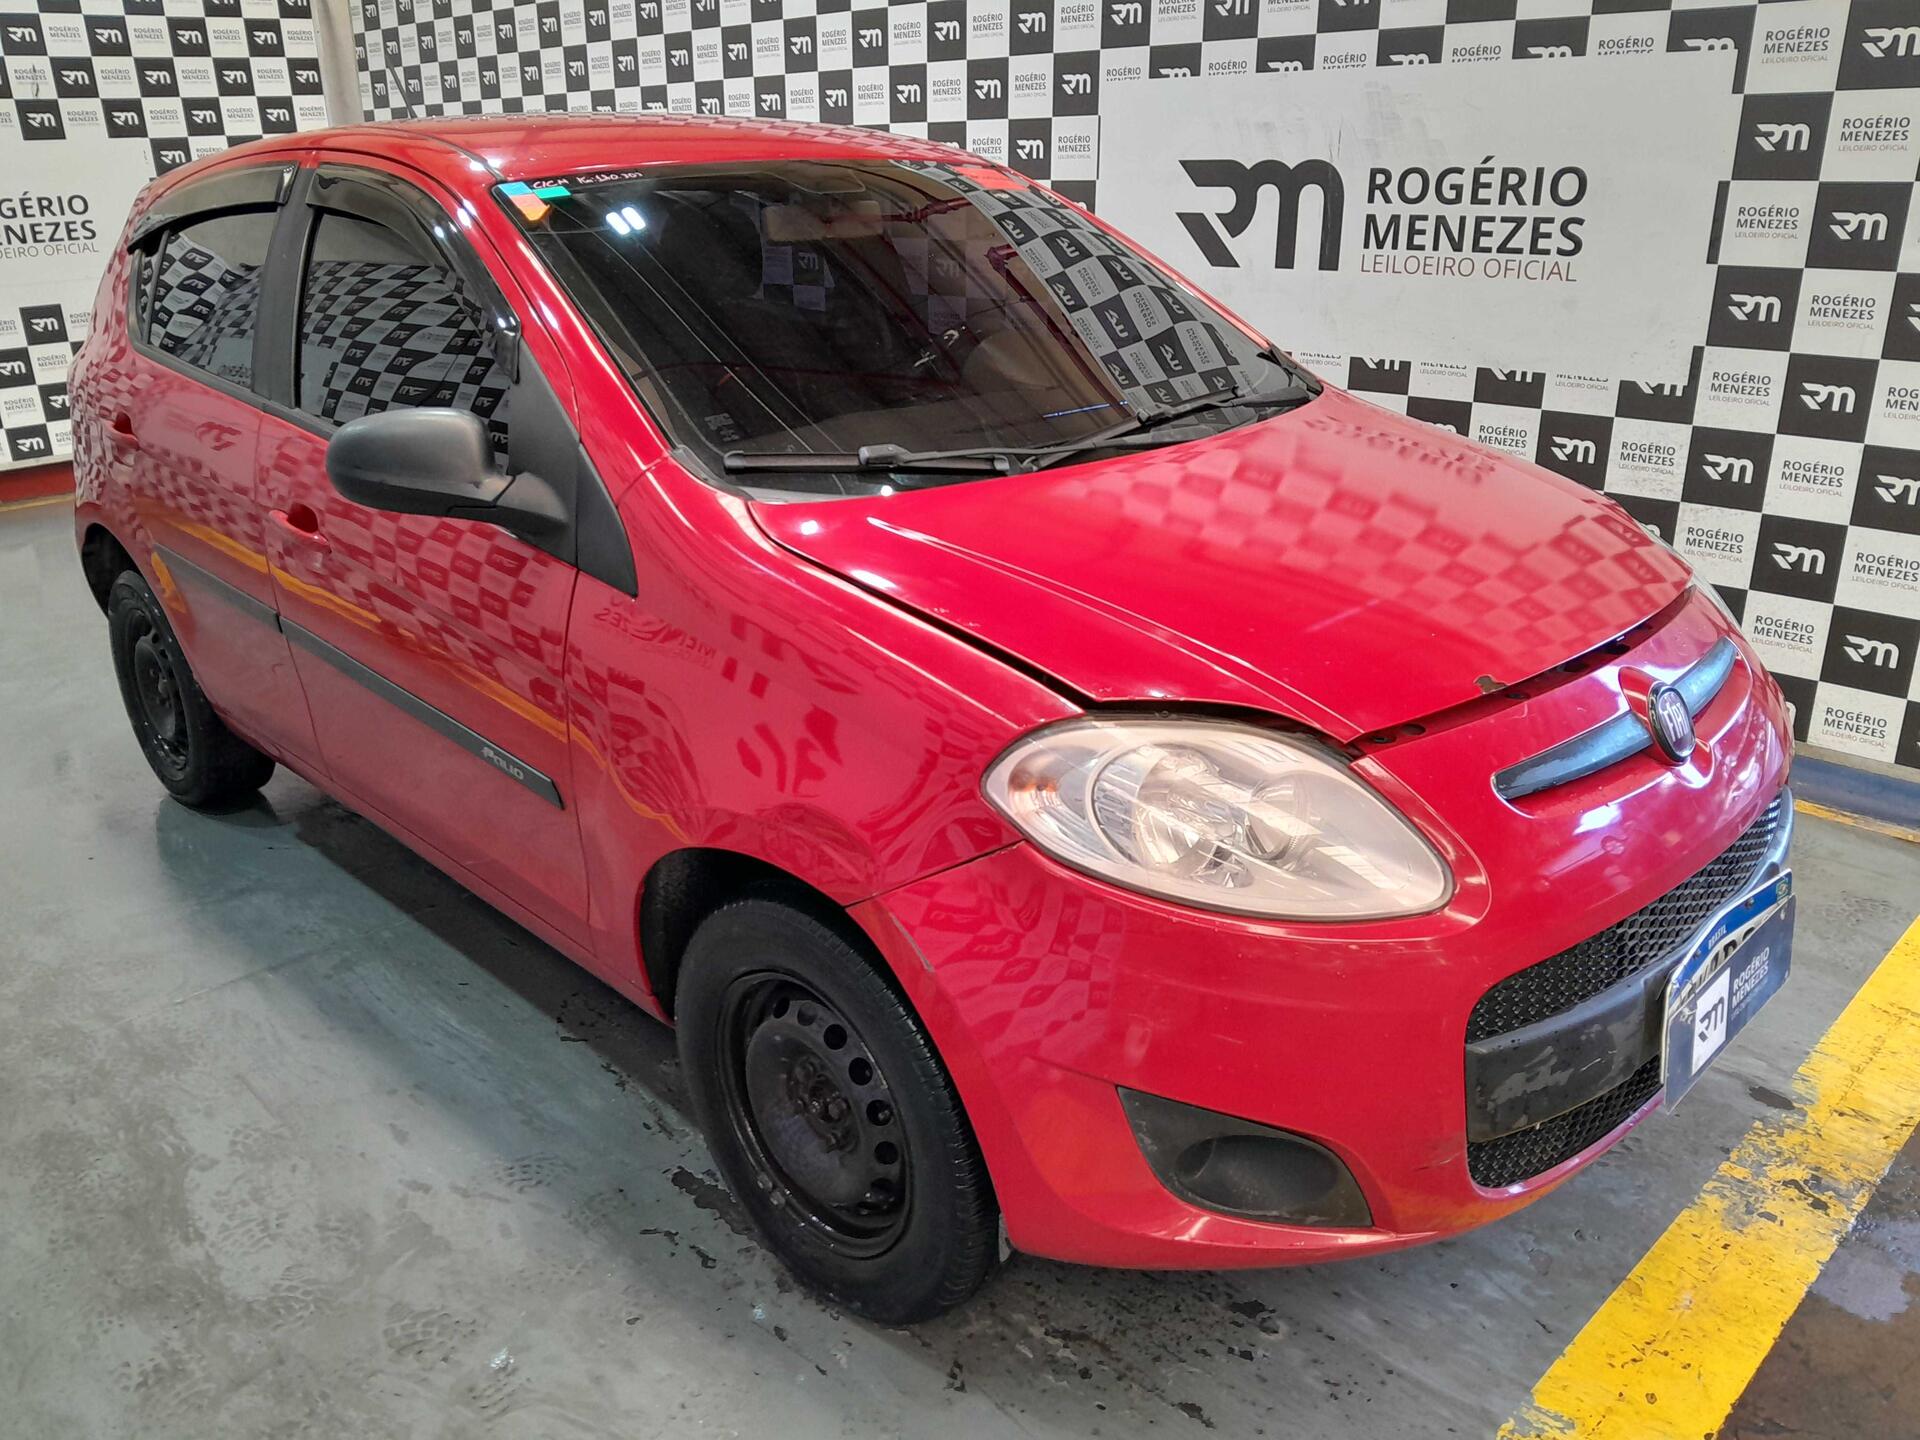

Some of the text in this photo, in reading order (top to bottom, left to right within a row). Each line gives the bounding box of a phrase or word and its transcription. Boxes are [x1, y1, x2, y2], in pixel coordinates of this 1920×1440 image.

[1597, 35, 1655, 52] ROGÉRIO
[1765, 26, 1831, 44] ROGÉRIO
[1451, 44, 1501, 59] ROGÉRIO
[1763, 40, 1829, 56] MENEZES
[1208, 59, 1247, 72] ROGÉRIO
[1322, 51, 1366, 66] ROGÉRIO
[1106, 65, 1141, 78] ROGÉRIO
[1841, 115, 1909, 131] ROGÉRIO
[1839, 130, 1908, 143] MENEZES
[1366, 155, 1588, 207] ROGÉRIO
[1737, 204, 1801, 219] ROGÉRIO
[0, 220, 97, 246] NEZES
[1735, 218, 1799, 231] MENEZES
[1362, 213, 1586, 257] MENEZES
[43, 242, 99, 256] OFICIAL
[1360, 254, 1577, 282] LEILOEIRO OFICIAL
[1810, 292, 1878, 308] ROGÉRIO
[1808, 305, 1876, 320] MENEZES
[1711, 370, 1772, 387] ROGÉRIO
[1709, 381, 1770, 398] MENEZES
[1479, 424, 1527, 439] ROGÉRIO
[1477, 434, 1527, 449] MENEZES
[1620, 441, 1676, 457] ROGÉRIO
[1619, 451, 1675, 467] MENEZES
[1782, 459, 1845, 478] ROGÉRIO
[1780, 470, 1844, 489] MENEZES
[1686, 526, 1744, 544] ROGÉRIO
[1684, 536, 1743, 555] MENEZES
[1853, 562, 1920, 583] MENEZES
[1754, 615, 1815, 635] ROGÉRIO
[1752, 624, 1814, 646] MENEZES
[1825, 706, 1889, 729] ROGÉRIO
[1822, 716, 1887, 739] MENEZES
[1733, 946, 1770, 993] ROGÉRIO
[1732, 961, 1769, 1009] MENEZES
